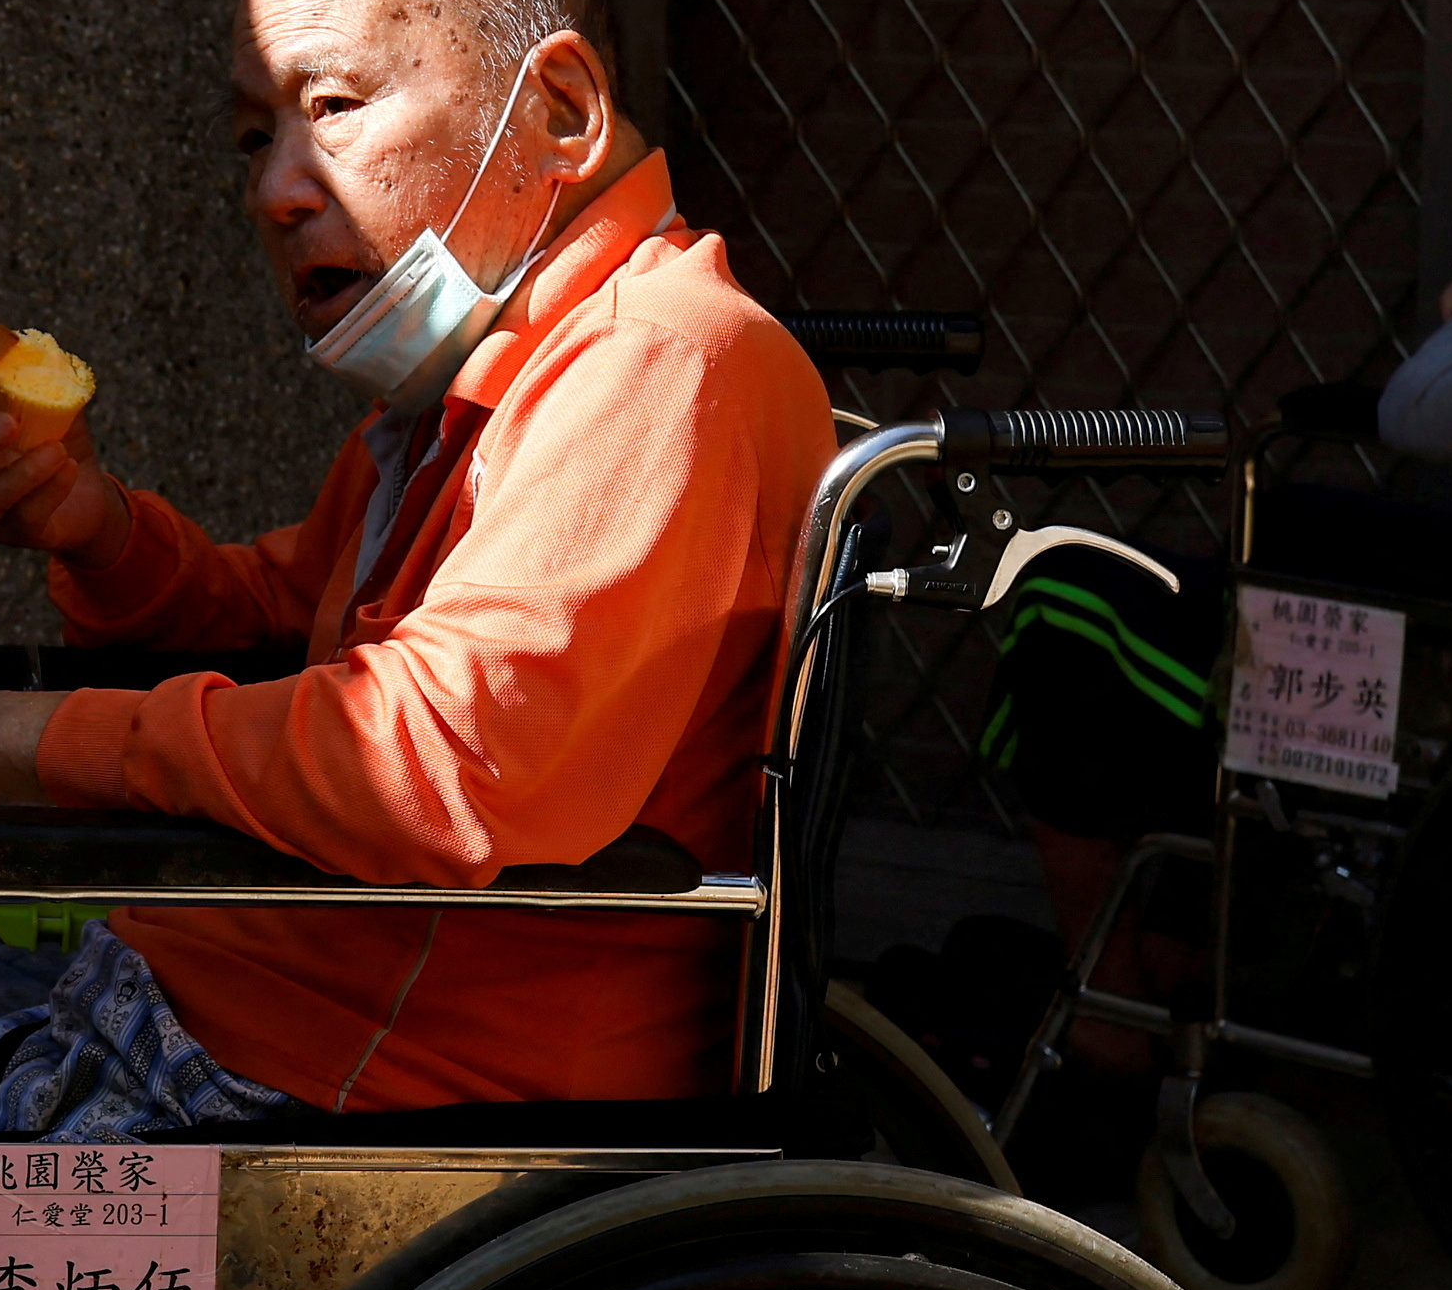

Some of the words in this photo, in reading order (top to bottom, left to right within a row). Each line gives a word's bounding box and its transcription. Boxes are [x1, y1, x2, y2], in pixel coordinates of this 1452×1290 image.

[1273, 597, 1370, 635] 桃園榮家
[1268, 663, 1387, 721] 郭步英
[12, 1202, 93, 1227] 仁愛堂
[102, 1203, 168, 1227] 203-1
